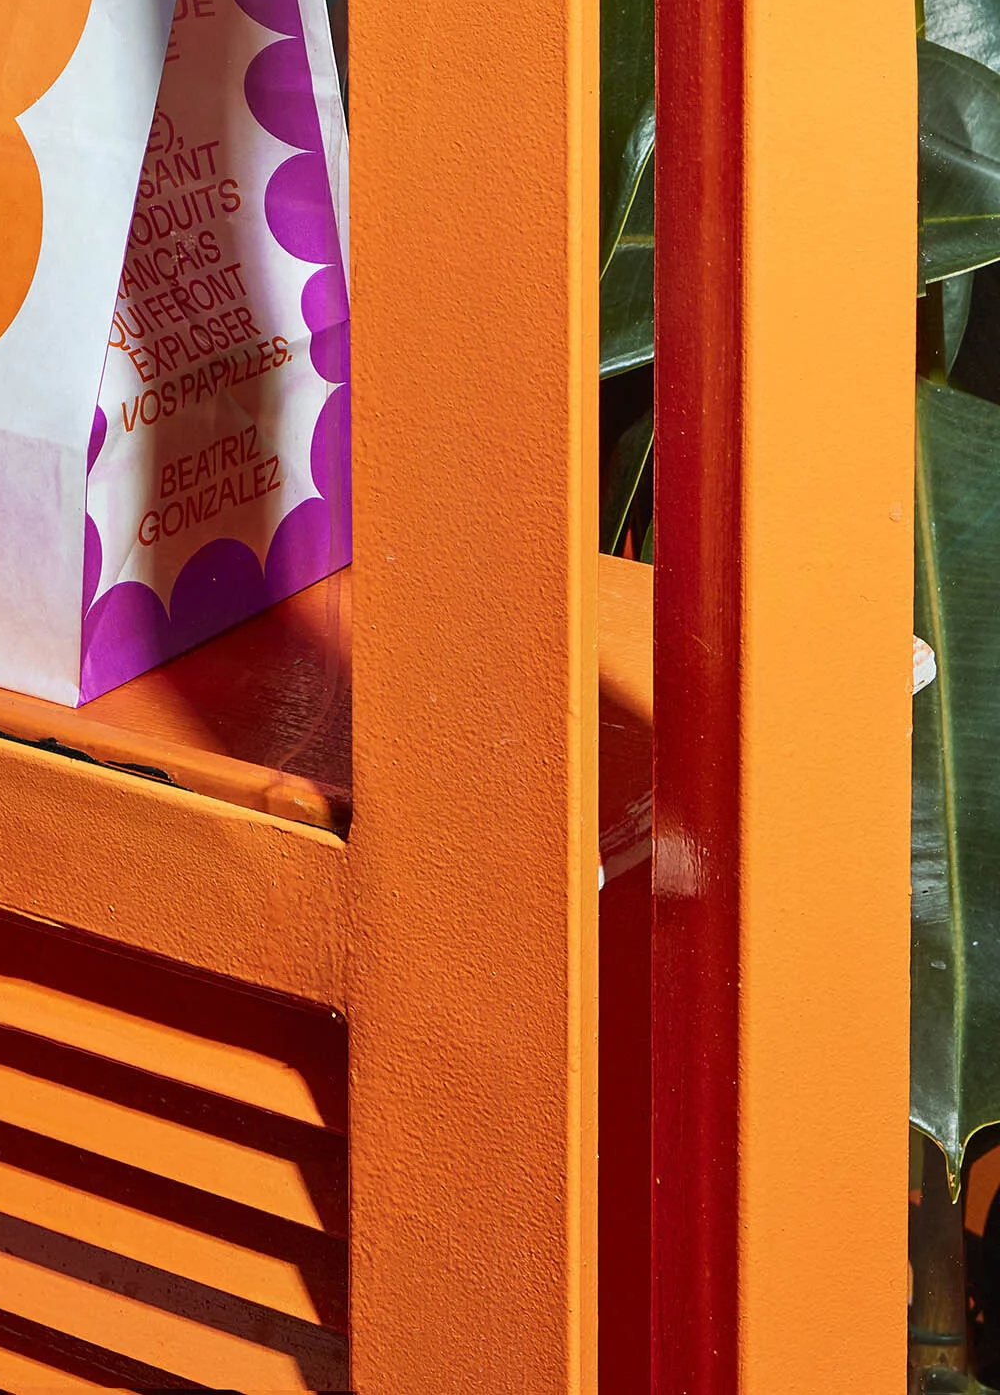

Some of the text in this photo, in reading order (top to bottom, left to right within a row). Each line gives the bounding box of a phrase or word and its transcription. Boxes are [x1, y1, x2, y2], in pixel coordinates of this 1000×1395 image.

[128, 179, 241, 249] ODUITS
[118, 231, 221, 299] ANÇAIS
[143, 263, 248, 329] FERONT
[127, 307, 261, 383] EXPLOSER
[121, 336, 293, 433] VOS PAPILLES.
[160, 424, 261, 499] BEATRIZ
[138, 455, 282, 547] GONZALEZ
